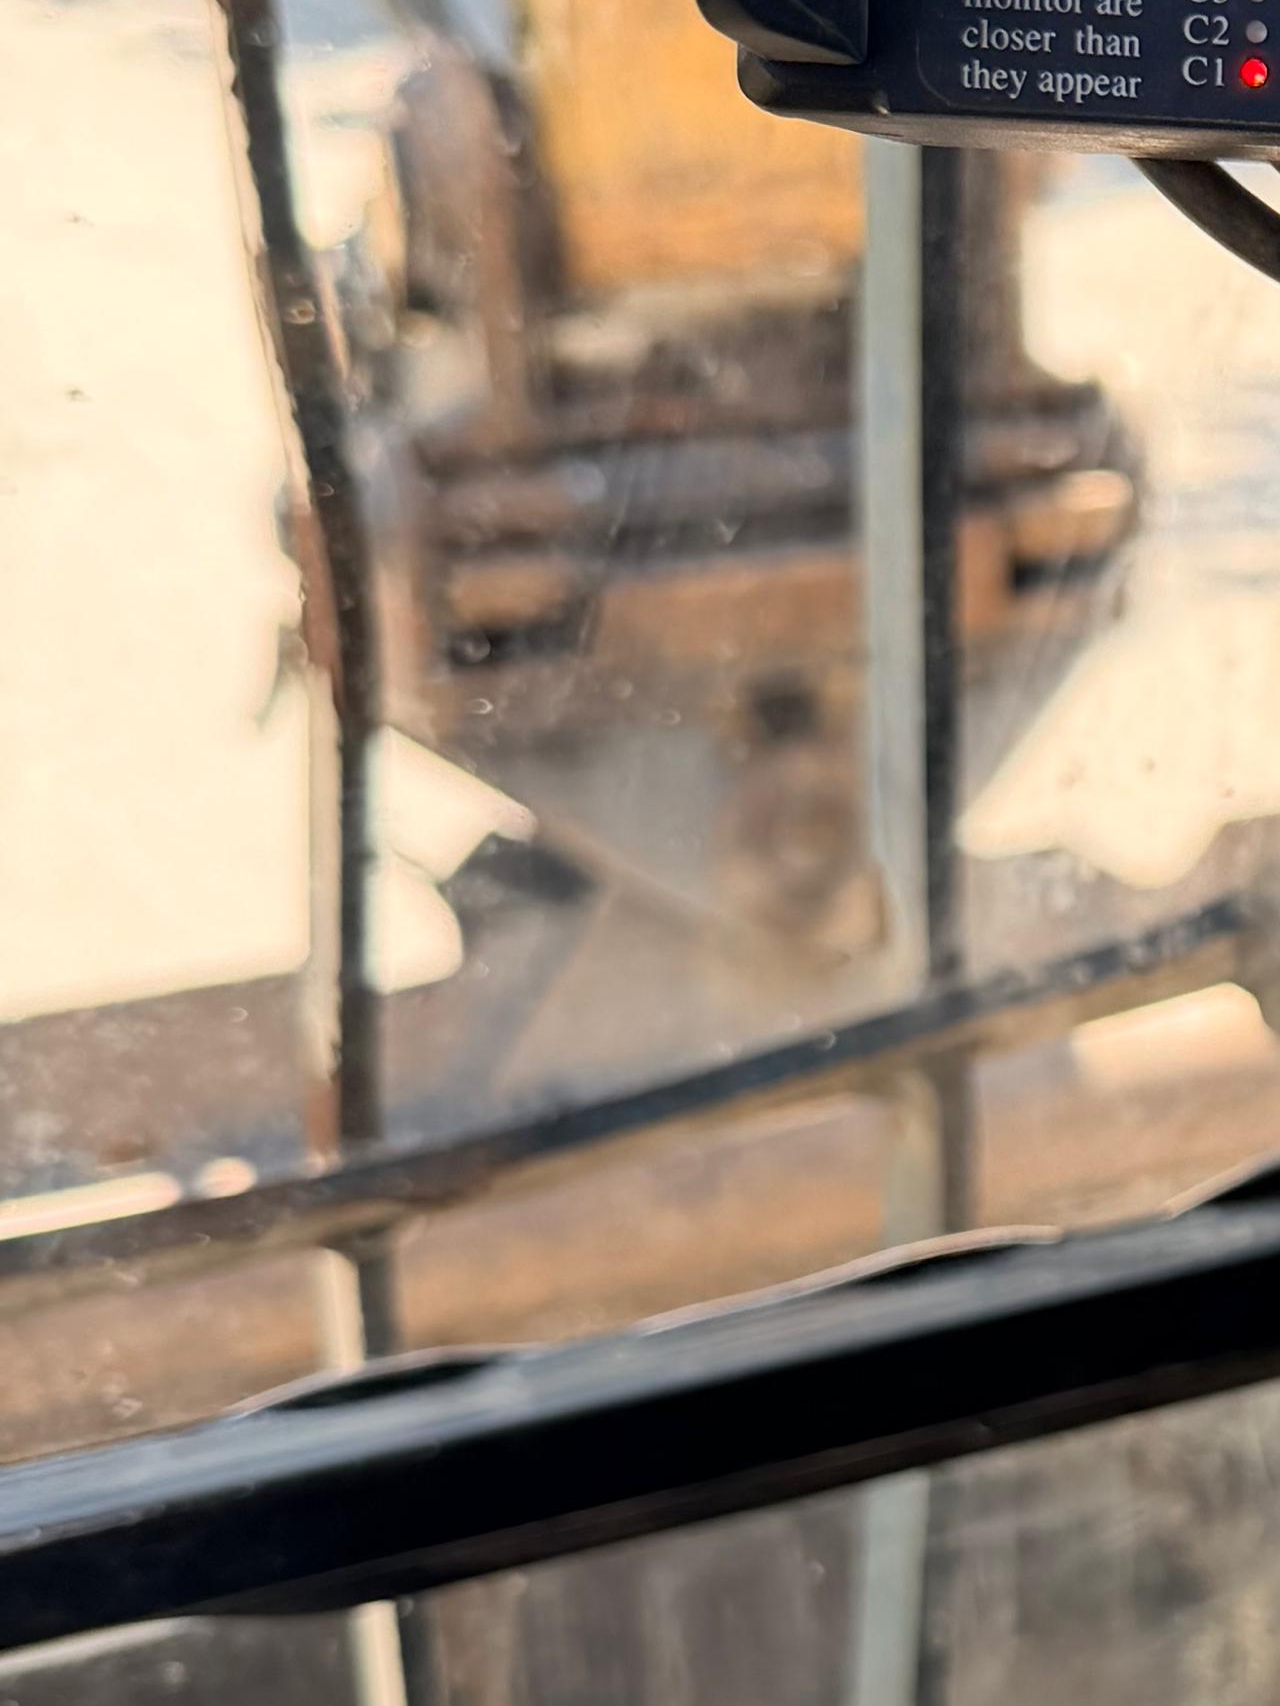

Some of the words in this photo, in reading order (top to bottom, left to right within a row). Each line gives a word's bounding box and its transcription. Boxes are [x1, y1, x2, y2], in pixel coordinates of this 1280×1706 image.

[961, 19, 1056, 53] closer
[1074, 25, 1141, 58] than
[1183, 16, 1230, 46] C2
[961, 61, 1028, 100] they
[1038, 69, 1142, 104] appear
[1182, 56, 1225, 87] C1
